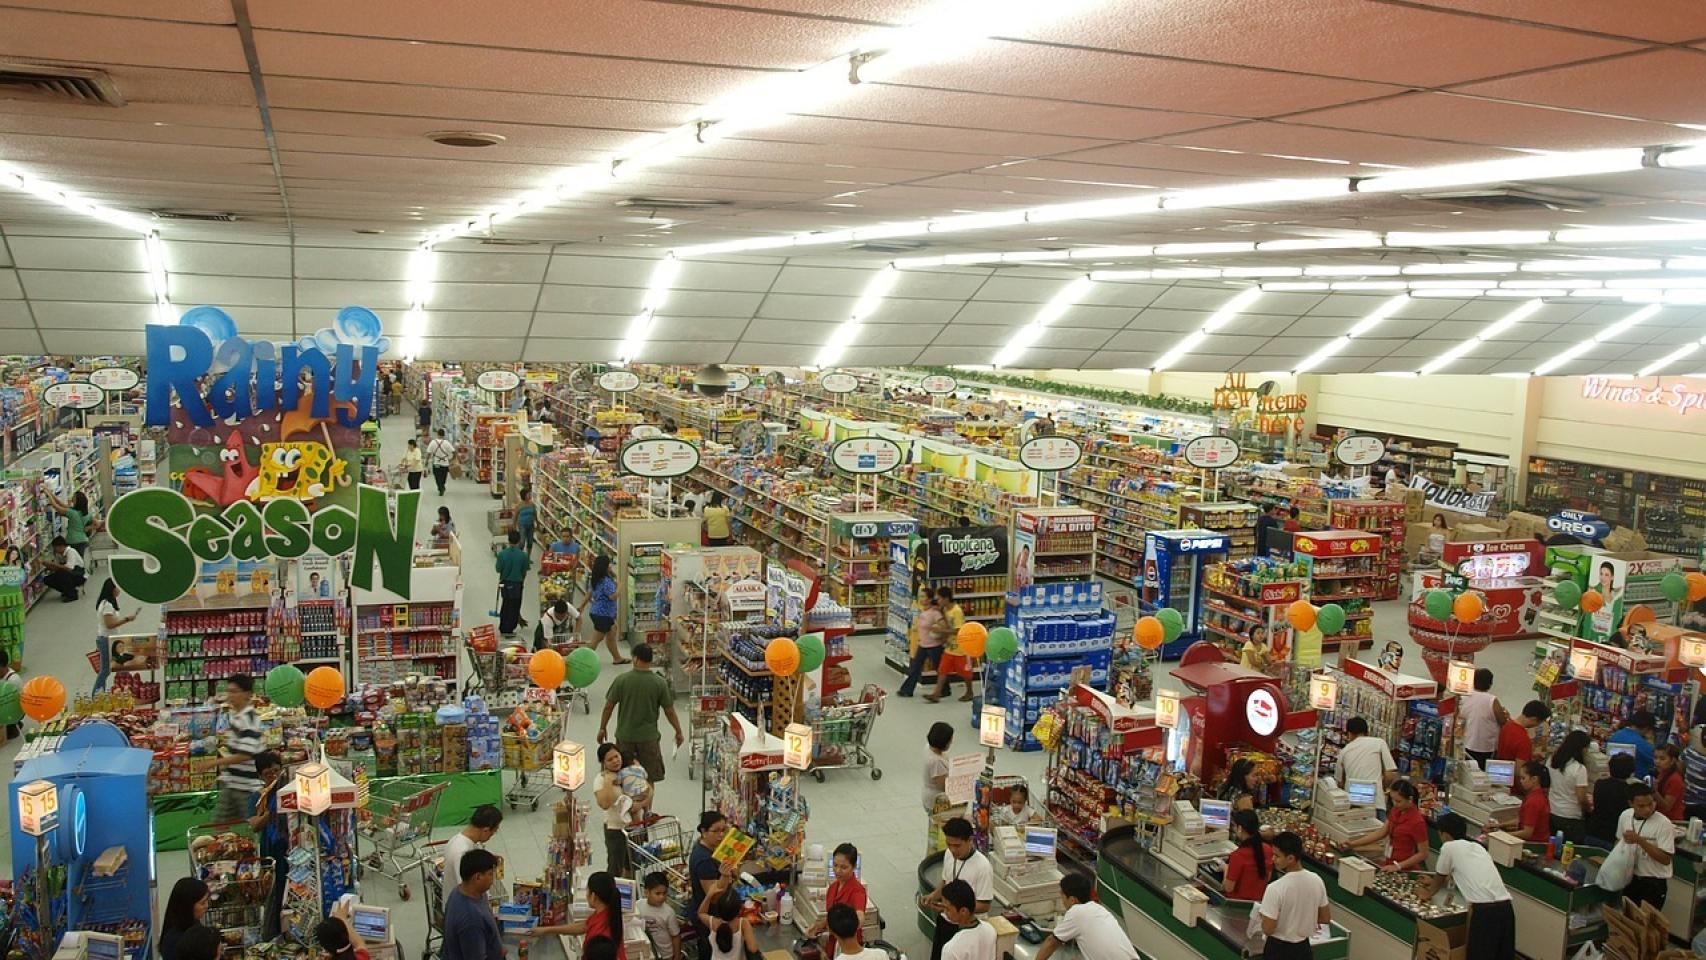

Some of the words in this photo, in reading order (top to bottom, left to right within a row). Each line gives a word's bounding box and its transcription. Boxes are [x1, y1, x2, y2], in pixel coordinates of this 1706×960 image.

[145, 325, 379, 428] Rainy
[1222, 371, 1247, 389] All
[1213, 390, 1256, 410] new
[1258, 392, 1308, 413] items
[1582, 376, 1642, 403] Wines
[1645, 386, 1664, 404] &
[1667, 383, 1706, 415] Spi
[1259, 413, 1305, 435] here
[1561, 511, 1583, 521] ONLY
[1548, 518, 1596, 537] OREO
[938, 534, 996, 555] Tropicana
[1191, 538, 1223, 549] PEPSI
[1486, 544, 1499, 552] Ice
[1501, 543, 1526, 551] Cream
[1628, 562, 1645, 576] 2X
[734, 584, 762, 592] ALASKA
[1693, 643, 1702, 656] 6
[1583, 655, 1592, 668] 7
[1459, 669, 1467, 682] 8
[1320, 682, 1329, 697] 9
[1161, 699, 1174, 714] 10
[988, 715, 999, 732] 11
[789, 735, 801, 752] 12
[558, 754, 570, 771] 13
[299, 777, 310, 796] 14
[318, 773, 328, 793] 14
[22, 795, 33, 815] 15
[40, 790, 55, 813] 15
